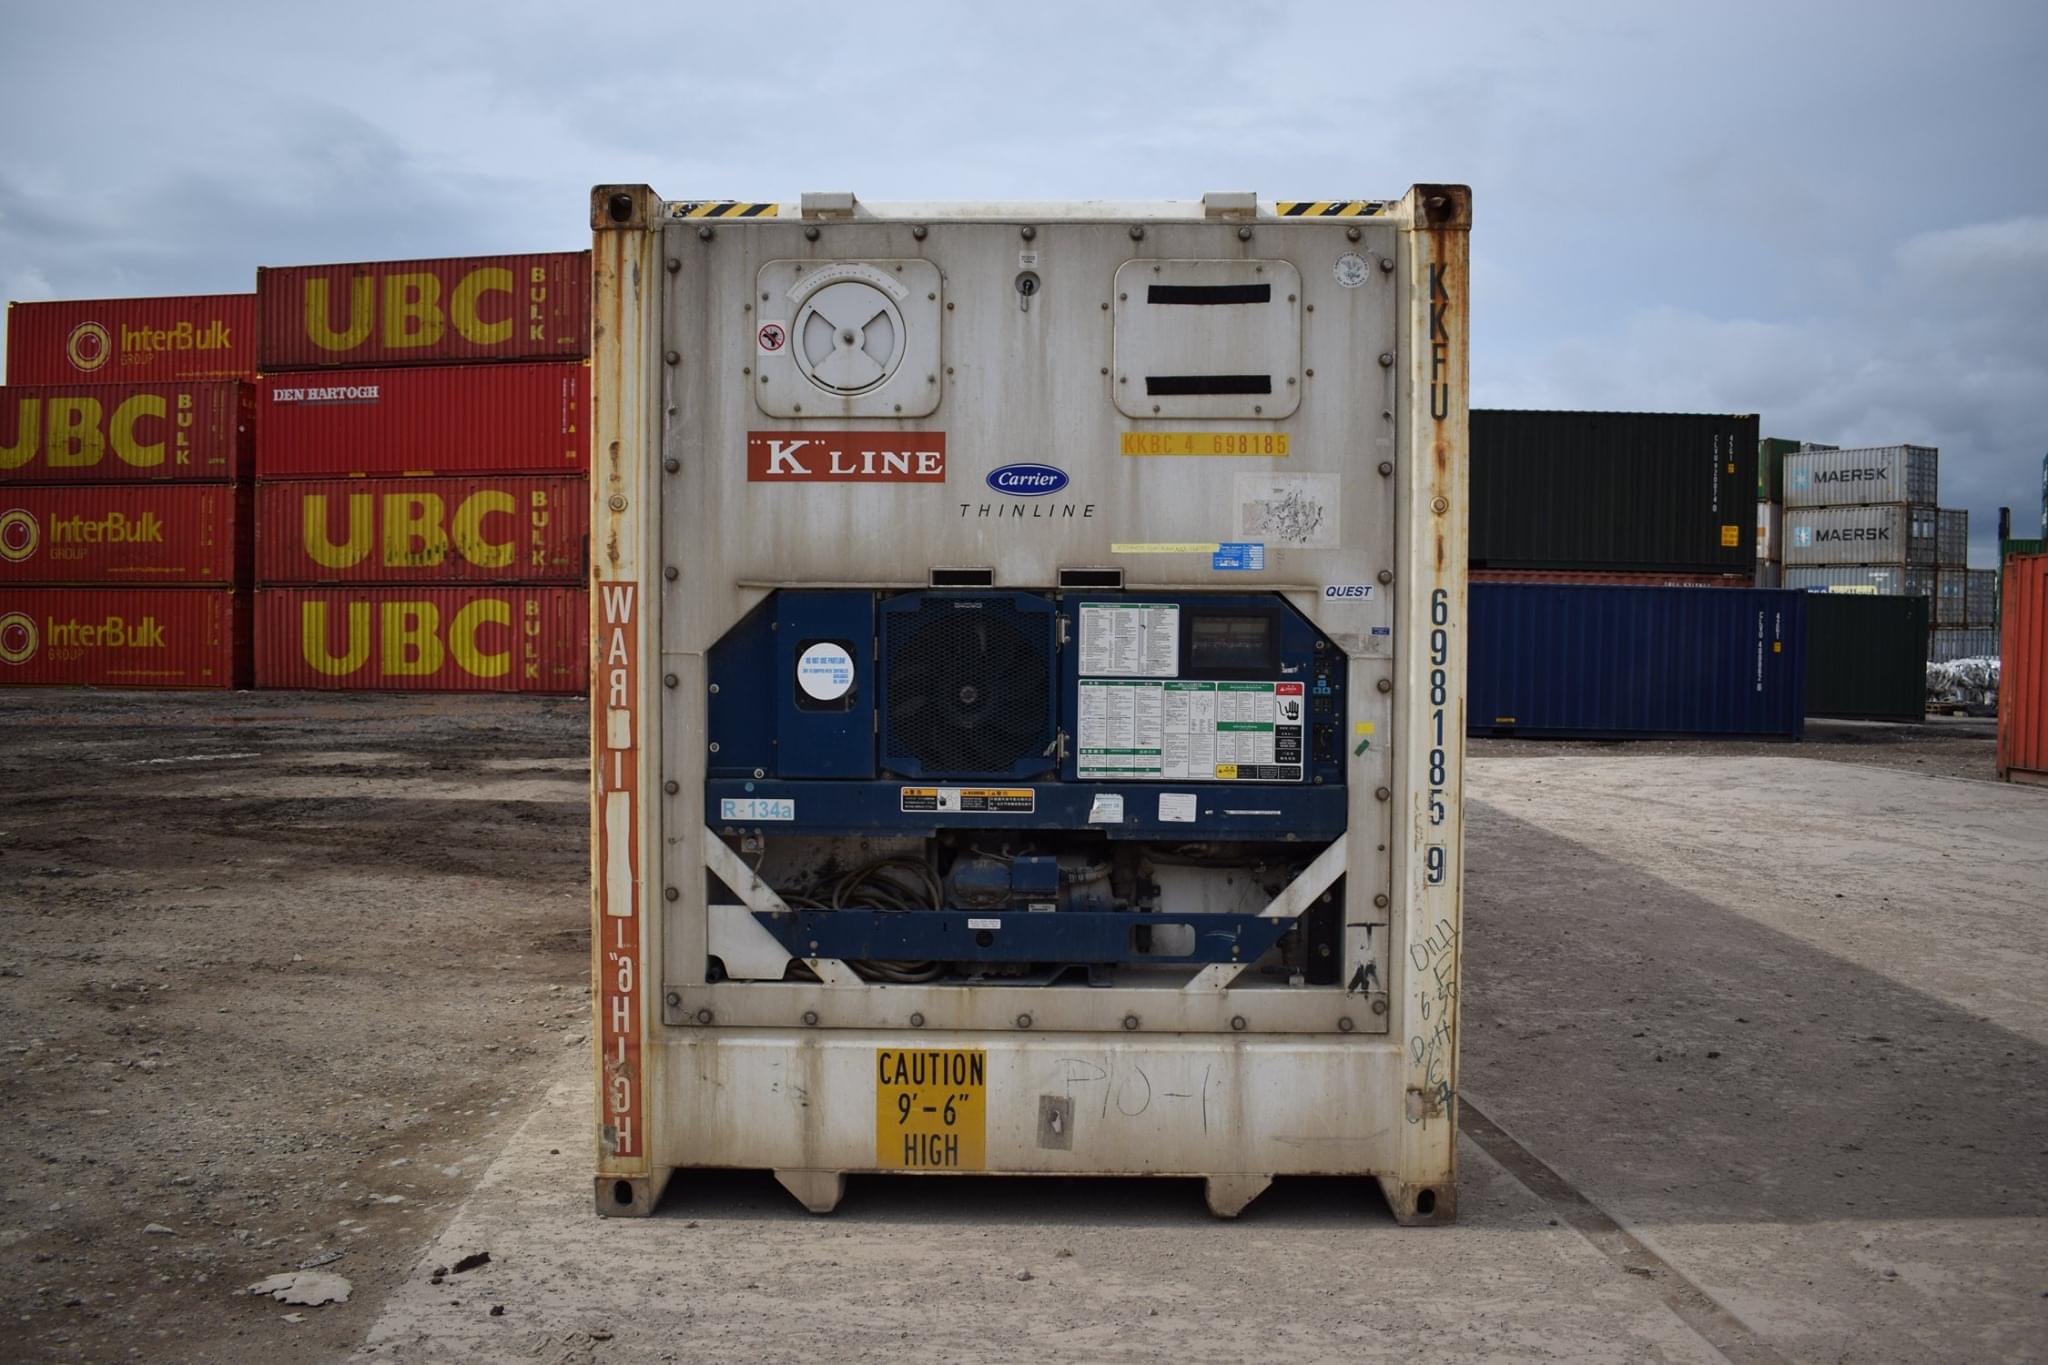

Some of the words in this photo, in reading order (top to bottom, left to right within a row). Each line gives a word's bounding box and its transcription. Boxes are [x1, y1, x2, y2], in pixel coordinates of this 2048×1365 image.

[305, 268, 514, 352] UBC
[531, 267, 546, 340] BULK
[121, 320, 232, 352] InterBulk
[1429, 263, 1449, 421] KKFU
[273, 388, 305, 401] DEN
[307, 386, 379, 401] HARTOGH
[176, 394, 193, 465] BULK
[1184, 434, 1194, 454] 4
[1213, 435, 1287, 454] 698185
[829, 451, 944, 474] LINE
[998, 471, 1058, 486] Carrier
[1814, 467, 1888, 484] MAERSK
[50, 511, 164, 543] InterBulk
[960, 503, 1096, 518] THINLINE
[303, 490, 516, 569] UBC
[532, 491, 548, 566] BULK
[1815, 528, 1889, 542] MAERSK
[1325, 586, 1372, 597] QUEST
[47, 616, 166, 647] InterBulk
[302, 598, 511, 677] UBC
[525, 600, 540, 679] BULK
[1428, 589, 1448, 825] 698185
[1427, 846, 1444, 883] 9
[879, 1053, 984, 1087] CAUTION
[903, 1133, 958, 1167] HIGH
